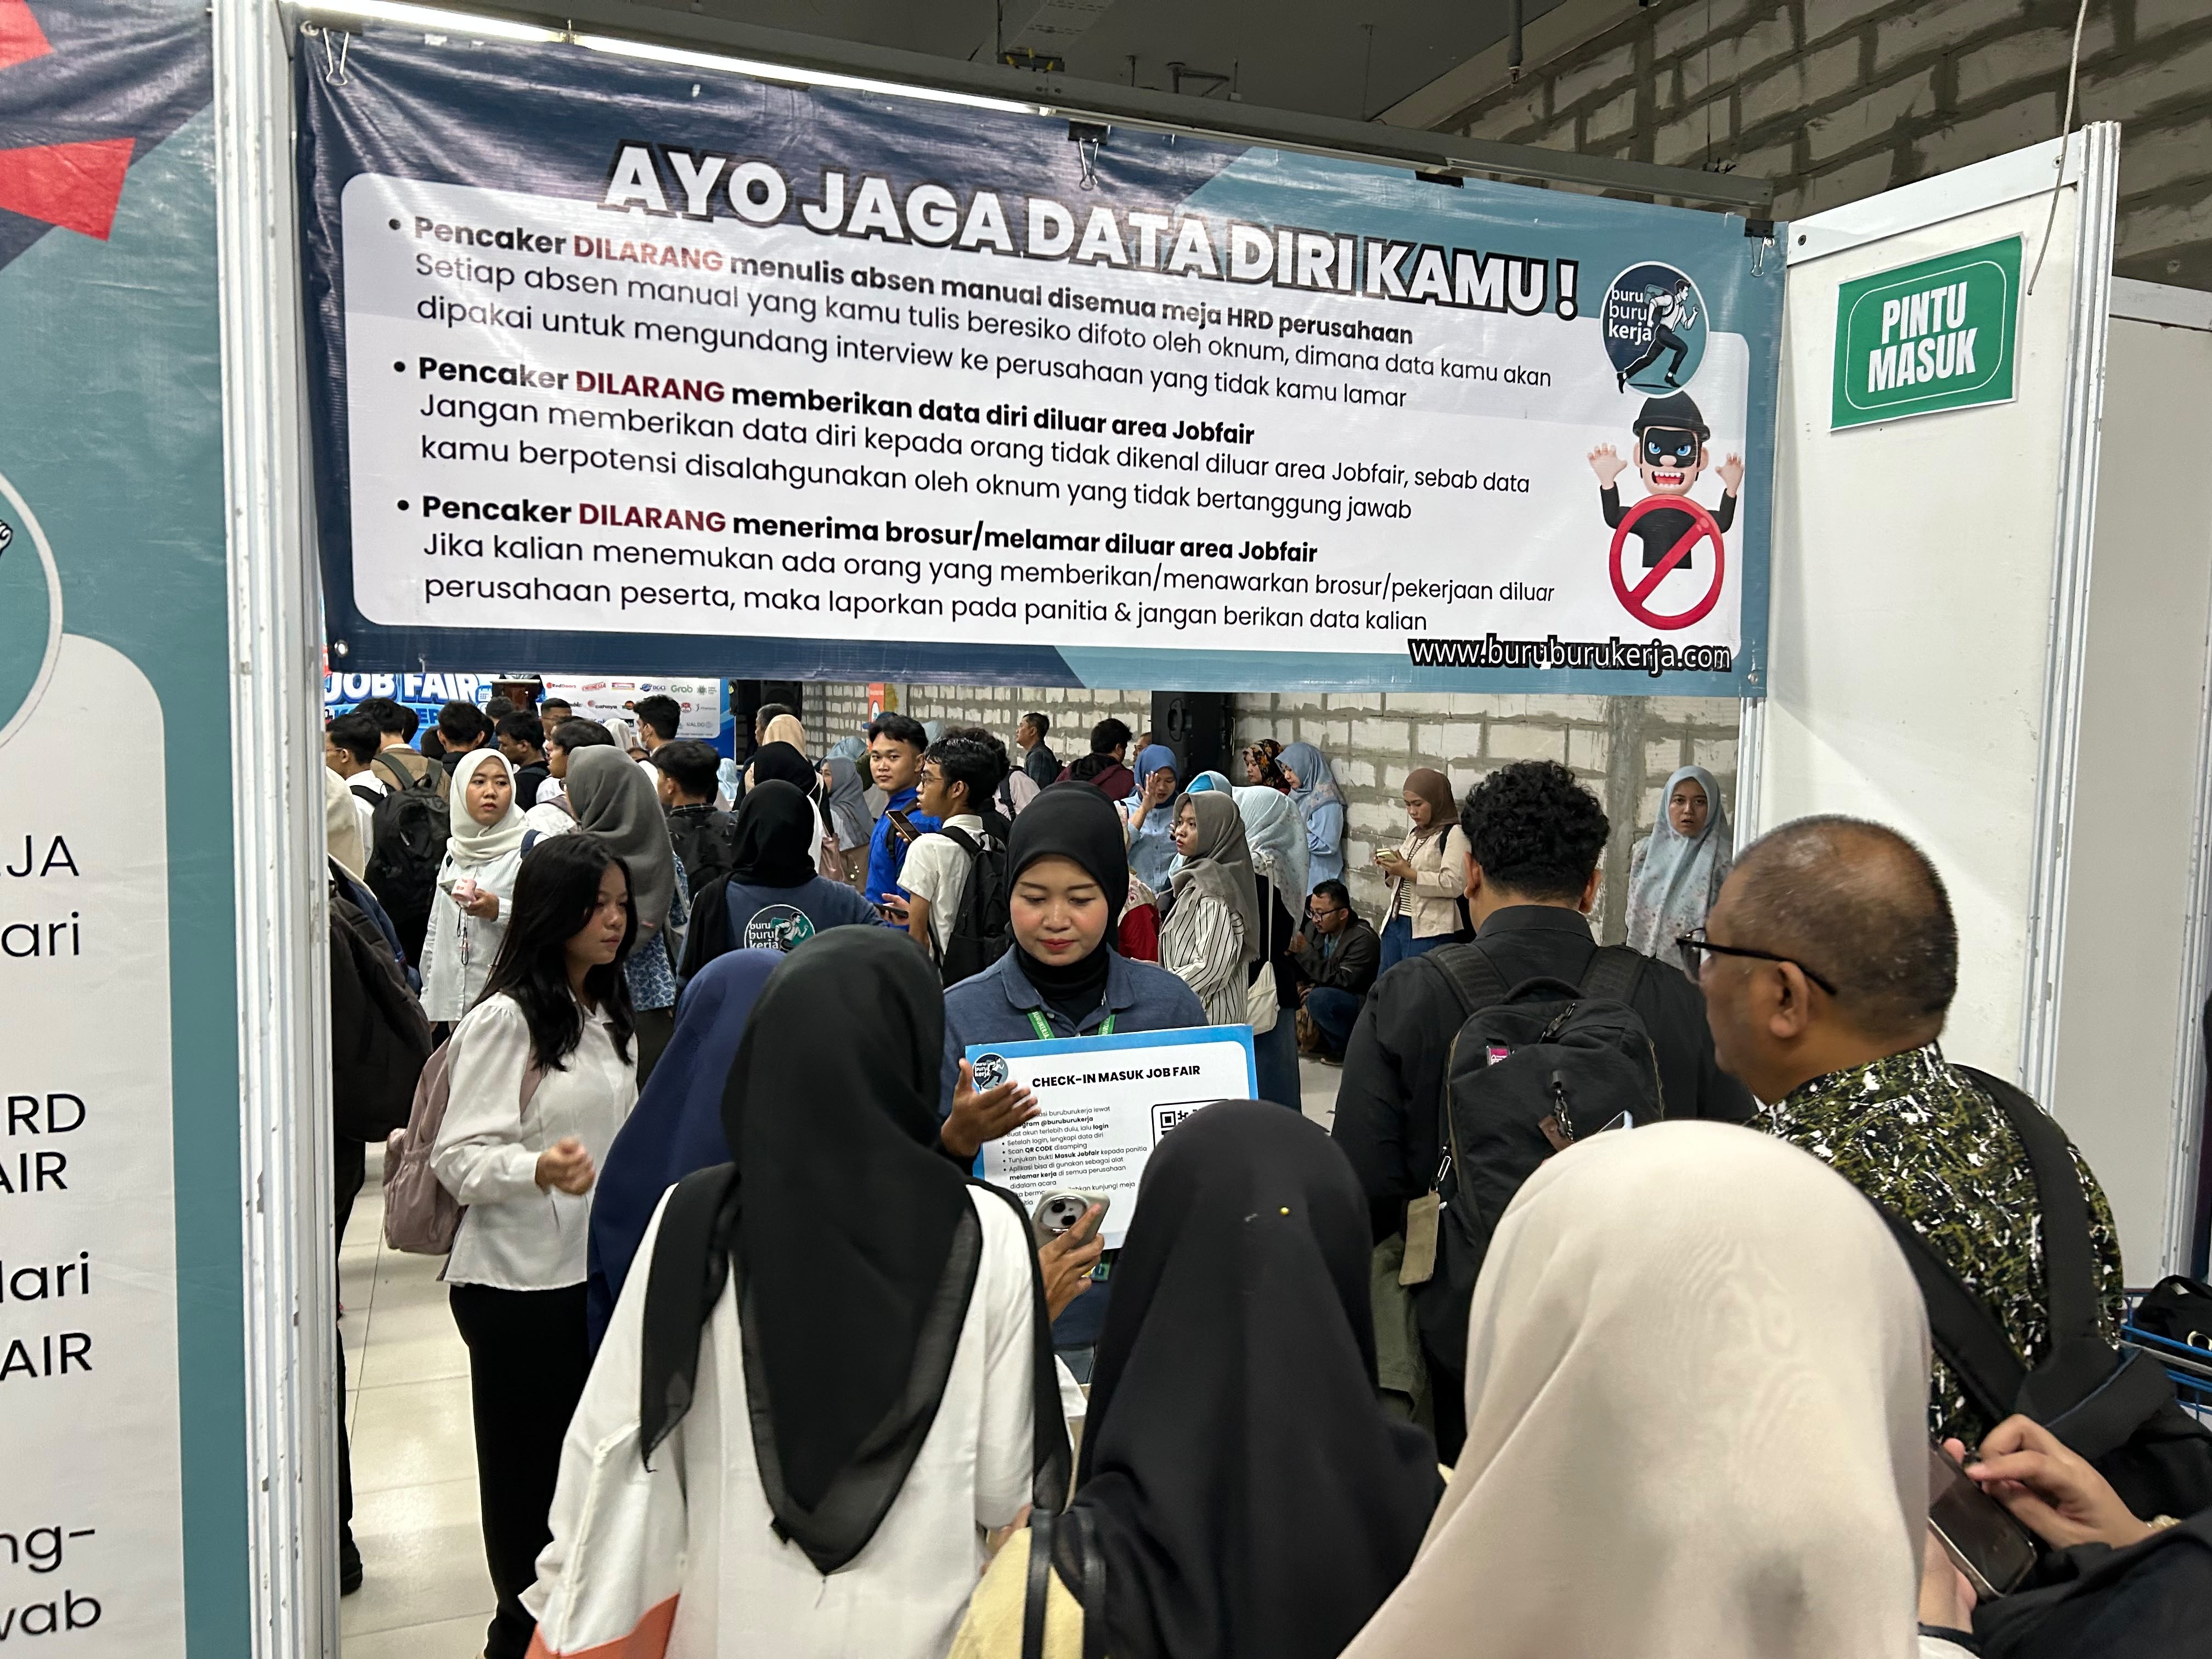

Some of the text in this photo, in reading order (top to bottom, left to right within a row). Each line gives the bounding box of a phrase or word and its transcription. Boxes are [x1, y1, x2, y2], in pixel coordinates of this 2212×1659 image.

[601, 143, 1545, 312] AYO JAGA DATA DIRI KAMU
[414, 215, 1413, 345] Pencaker DILARANG menulis absen manual disemua meja HRD perusahaan
[1611, 289, 1644, 303] buru
[416, 253, 1551, 387] Setiap absen manual yang kamu tulis beresiko difoto oleh oknum, dimana data kamu akan
[1609, 300, 1647, 321] buru
[1881, 281, 1968, 345] PINTU
[417, 295, 1407, 407] dipakai untuk mengundang interview ke perusahaan yang tidak kamu lamar
[1609, 319, 1652, 345] kerja
[1867, 327, 1978, 393] MASUK
[419, 357, 1255, 445] Pencaker DILARANG memberikan data diri diluar area Jobfair
[420, 393, 1529, 493] Jangan memberikan data diri kepada orang tidak dikenal diluar area Jobfair, sebab data
[422, 435, 1412, 522] kamu berpotensi disalahgunakan oleh oknum yang tidak bertanggung jawab
[422, 495, 1318, 562] Pencaker DILARANG menerima brosur/melamar diluar area Jobfair
[424, 532, 1555, 604] Jika kalian menemukan ada orang yang memberikan/menawarkan brosur/pekerjaan diluar
[425, 577, 1426, 630] perusahaan peserta, maka laporkan pada panitia & jangan berikan data kalian
[1411, 634, 1731, 674] www.buruburukerja.com
[324, 672, 478, 703] JOB FAIR
[670, 685, 693, 693] Grab
[0, 835, 79, 877] JA
[749, 921, 771, 930] buru
[749, 929, 775, 940] buru
[749, 939, 779, 950] kerja
[1032, 1065, 1200, 1087] CHECK-IN MASUK JOB FAIR
[1049, 1108, 1092, 1116] buruburukerja
[1056, 1160, 1084, 1169] gunakan
[1085, 1157, 1110, 1165] sebagai
[1088, 1165, 1126, 1175] perusahaan
[1101, 1148, 1124, 1156] kepada
[1126, 1146, 1147, 1154] panitia
[1092, 1182, 1119, 1191] kunjungi
[1119, 1181, 1136, 1189] meja
[0, 1251, 89, 1304] ari
